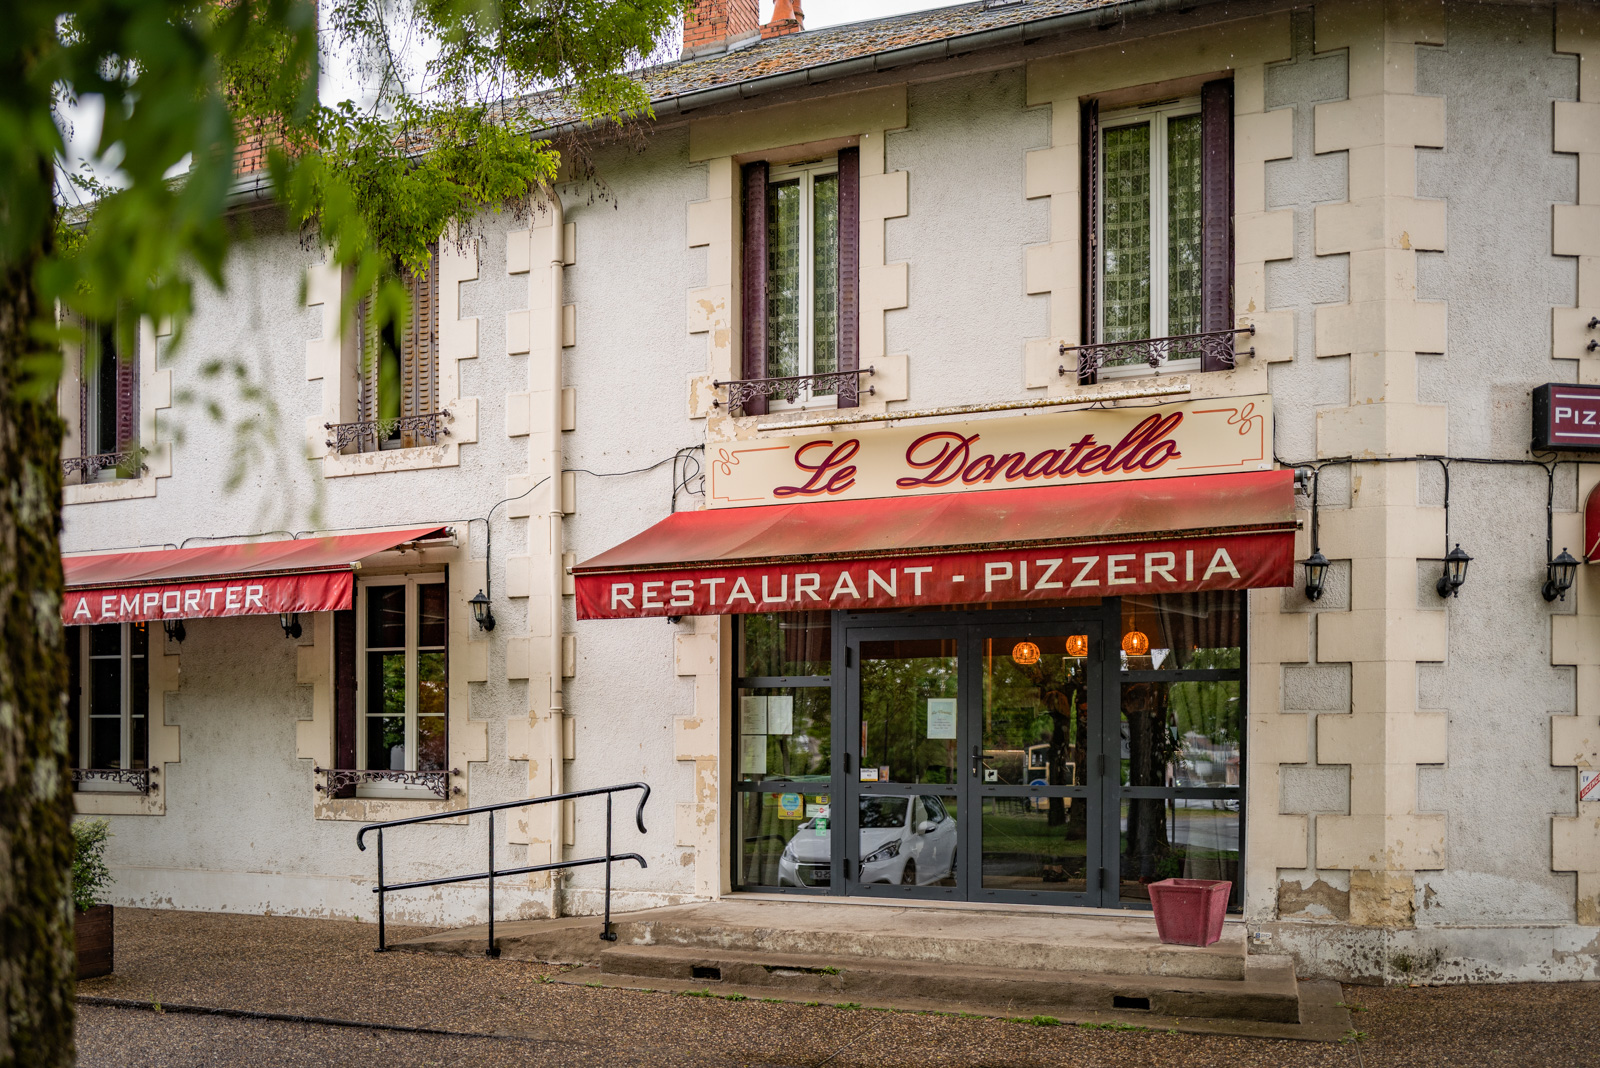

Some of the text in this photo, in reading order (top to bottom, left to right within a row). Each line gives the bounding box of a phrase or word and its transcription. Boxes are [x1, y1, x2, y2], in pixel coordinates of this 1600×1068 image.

[1555, 406, 1600, 425] PIZ
[773, 411, 1184, 498] Le Donatello
[73, 584, 264, 619] A EMPORTER
[610, 565, 933, 611] RESTAURANT
[984, 547, 1242, 593] PIZZERIA
